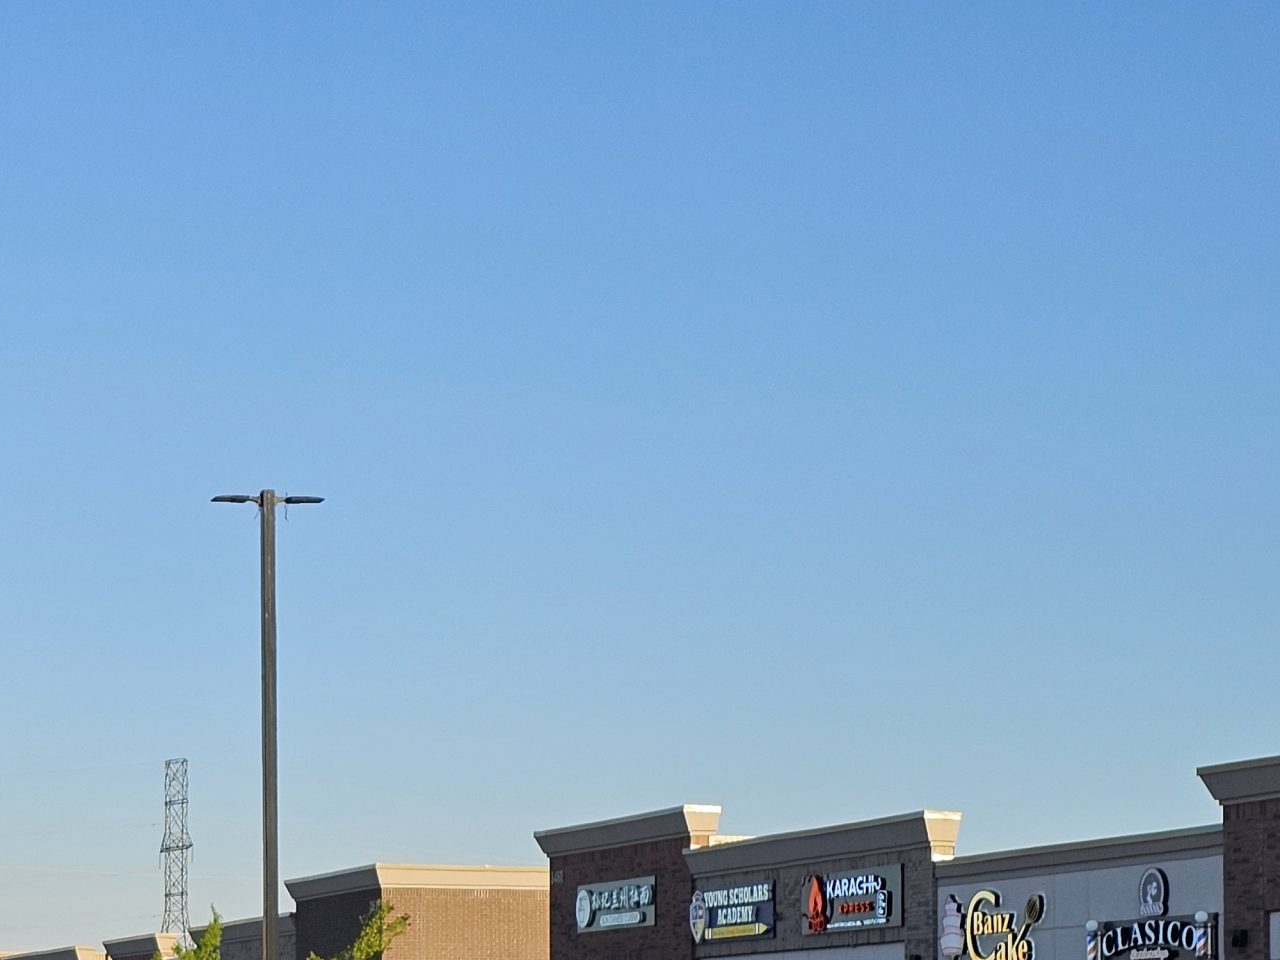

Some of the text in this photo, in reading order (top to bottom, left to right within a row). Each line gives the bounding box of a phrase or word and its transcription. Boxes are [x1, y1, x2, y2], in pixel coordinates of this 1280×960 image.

[704, 884, 769, 908] YOUNG SCHOLARS
[826, 875, 882, 900] KARACHI
[717, 906, 753, 925] ACADEMY
[973, 911, 1011, 936] Banz
[1102, 919, 1197, 957] CLASICO
